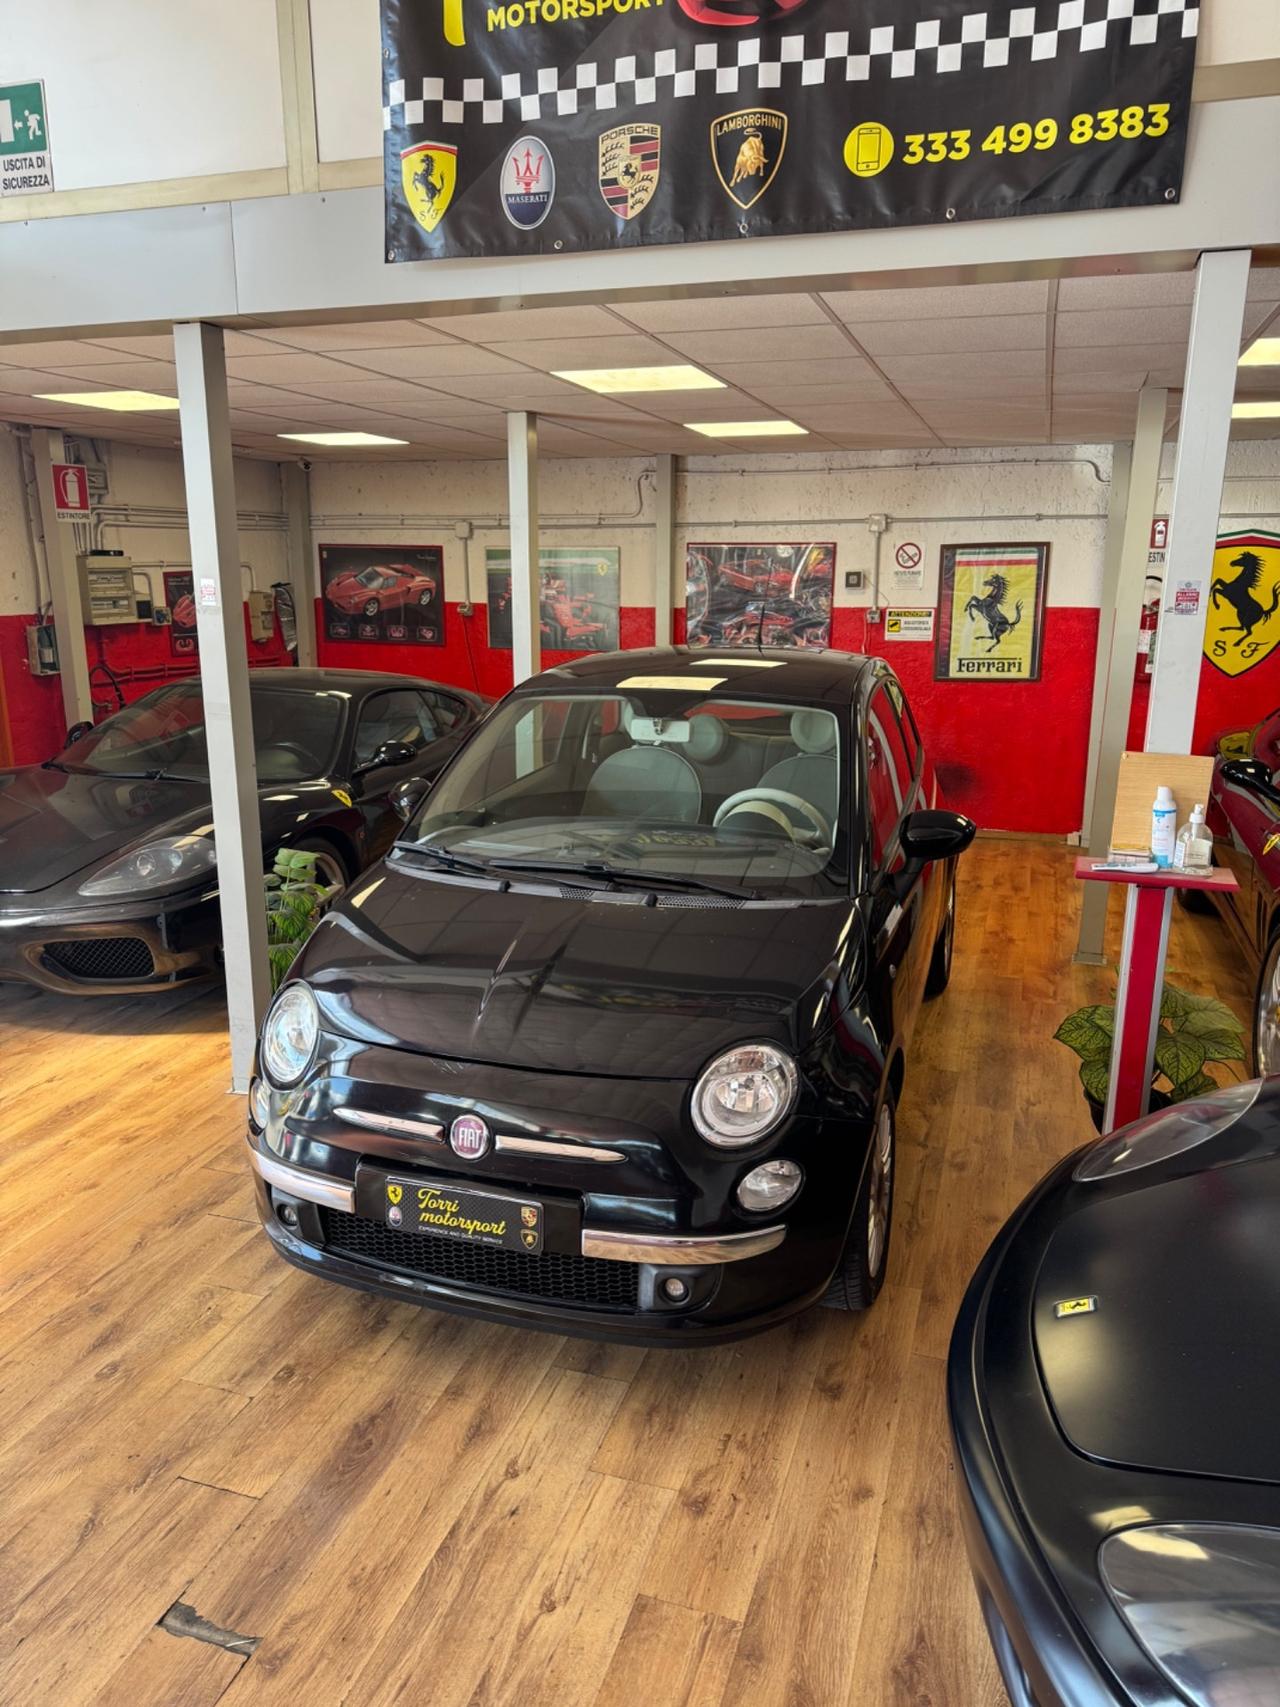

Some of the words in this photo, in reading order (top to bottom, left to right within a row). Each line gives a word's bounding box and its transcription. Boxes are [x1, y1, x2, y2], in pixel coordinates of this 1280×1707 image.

[487, 0, 663, 32] MOTORSPO
[717, 114, 782, 136] LAMBORGHINI
[902, 130, 971, 164] 333
[982, 118, 1058, 155] 499
[1069, 103, 1170, 144] 8383
[601, 126, 659, 144] PORSCHE
[3, 157, 35, 171] USCITA
[36, 155, 46, 168] DI
[2, 174, 50, 190] SICUREZZA
[508, 194, 548, 204] MASERATI
[57, 512, 91, 520] ESTINTORE
[1213, 640, 1227, 657] S
[1241, 641, 1271, 659] F
[956, 657, 1023, 673] Ferrari
[459, 1127, 483, 1149] FIAT
[418, 1188, 460, 1213] Torri
[419, 1211, 506, 1235] motorsport
